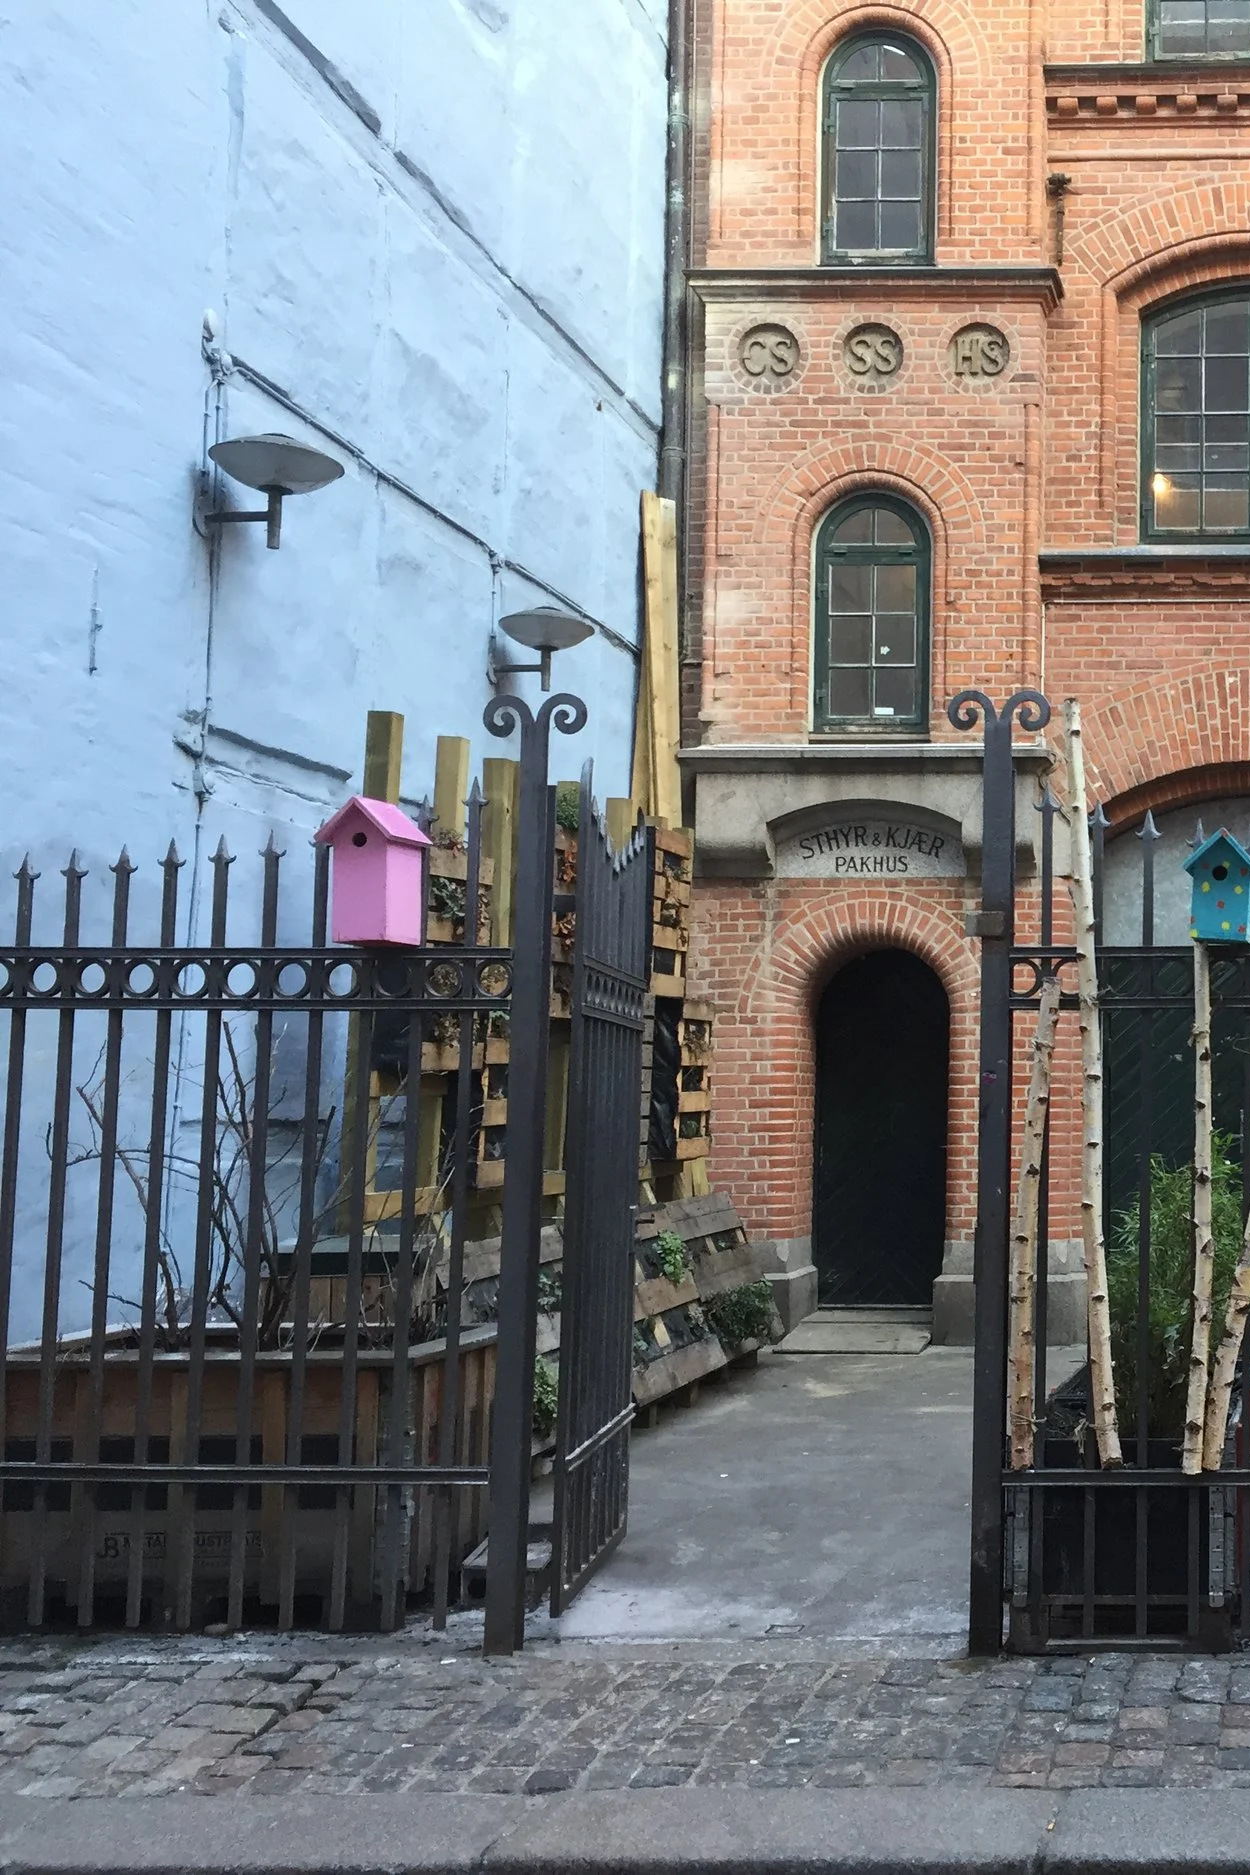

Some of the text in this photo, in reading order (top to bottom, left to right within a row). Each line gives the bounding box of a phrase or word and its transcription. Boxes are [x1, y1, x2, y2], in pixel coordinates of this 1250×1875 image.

[850, 339, 898, 374] SS
[799, 825, 945, 861] STHYR & KJÆR
[835, 855, 909, 873] PAKHUS
